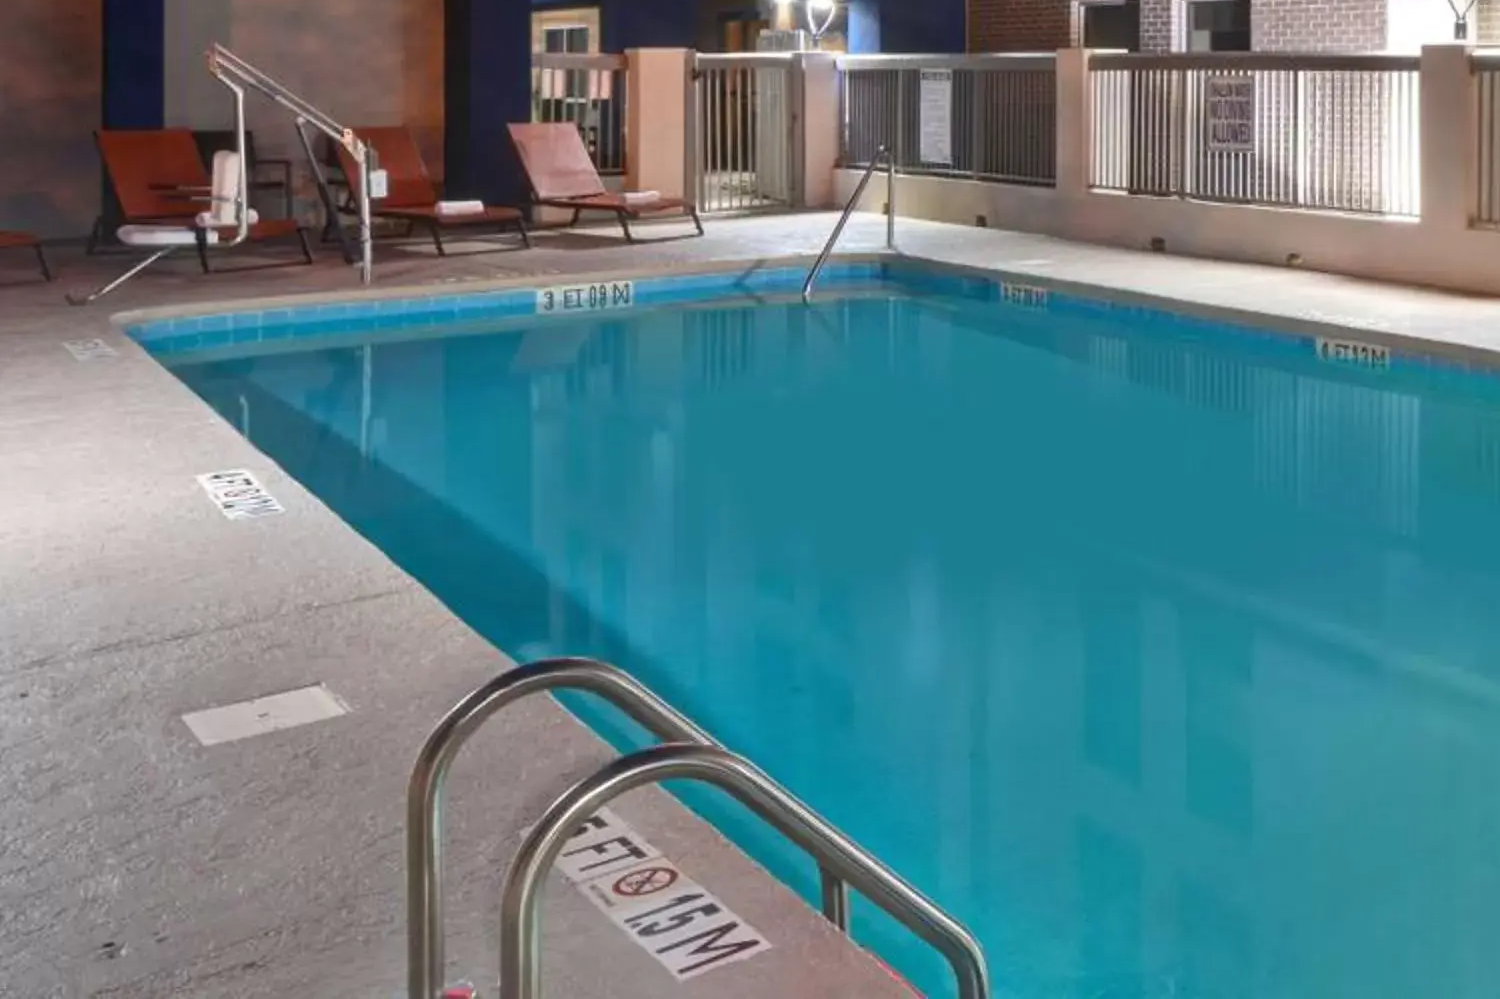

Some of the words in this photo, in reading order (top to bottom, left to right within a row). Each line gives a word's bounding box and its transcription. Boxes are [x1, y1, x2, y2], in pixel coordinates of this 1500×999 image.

[543, 290, 554, 311] 3
[562, 836, 647, 872] FT
[656, 920, 760, 974] M
